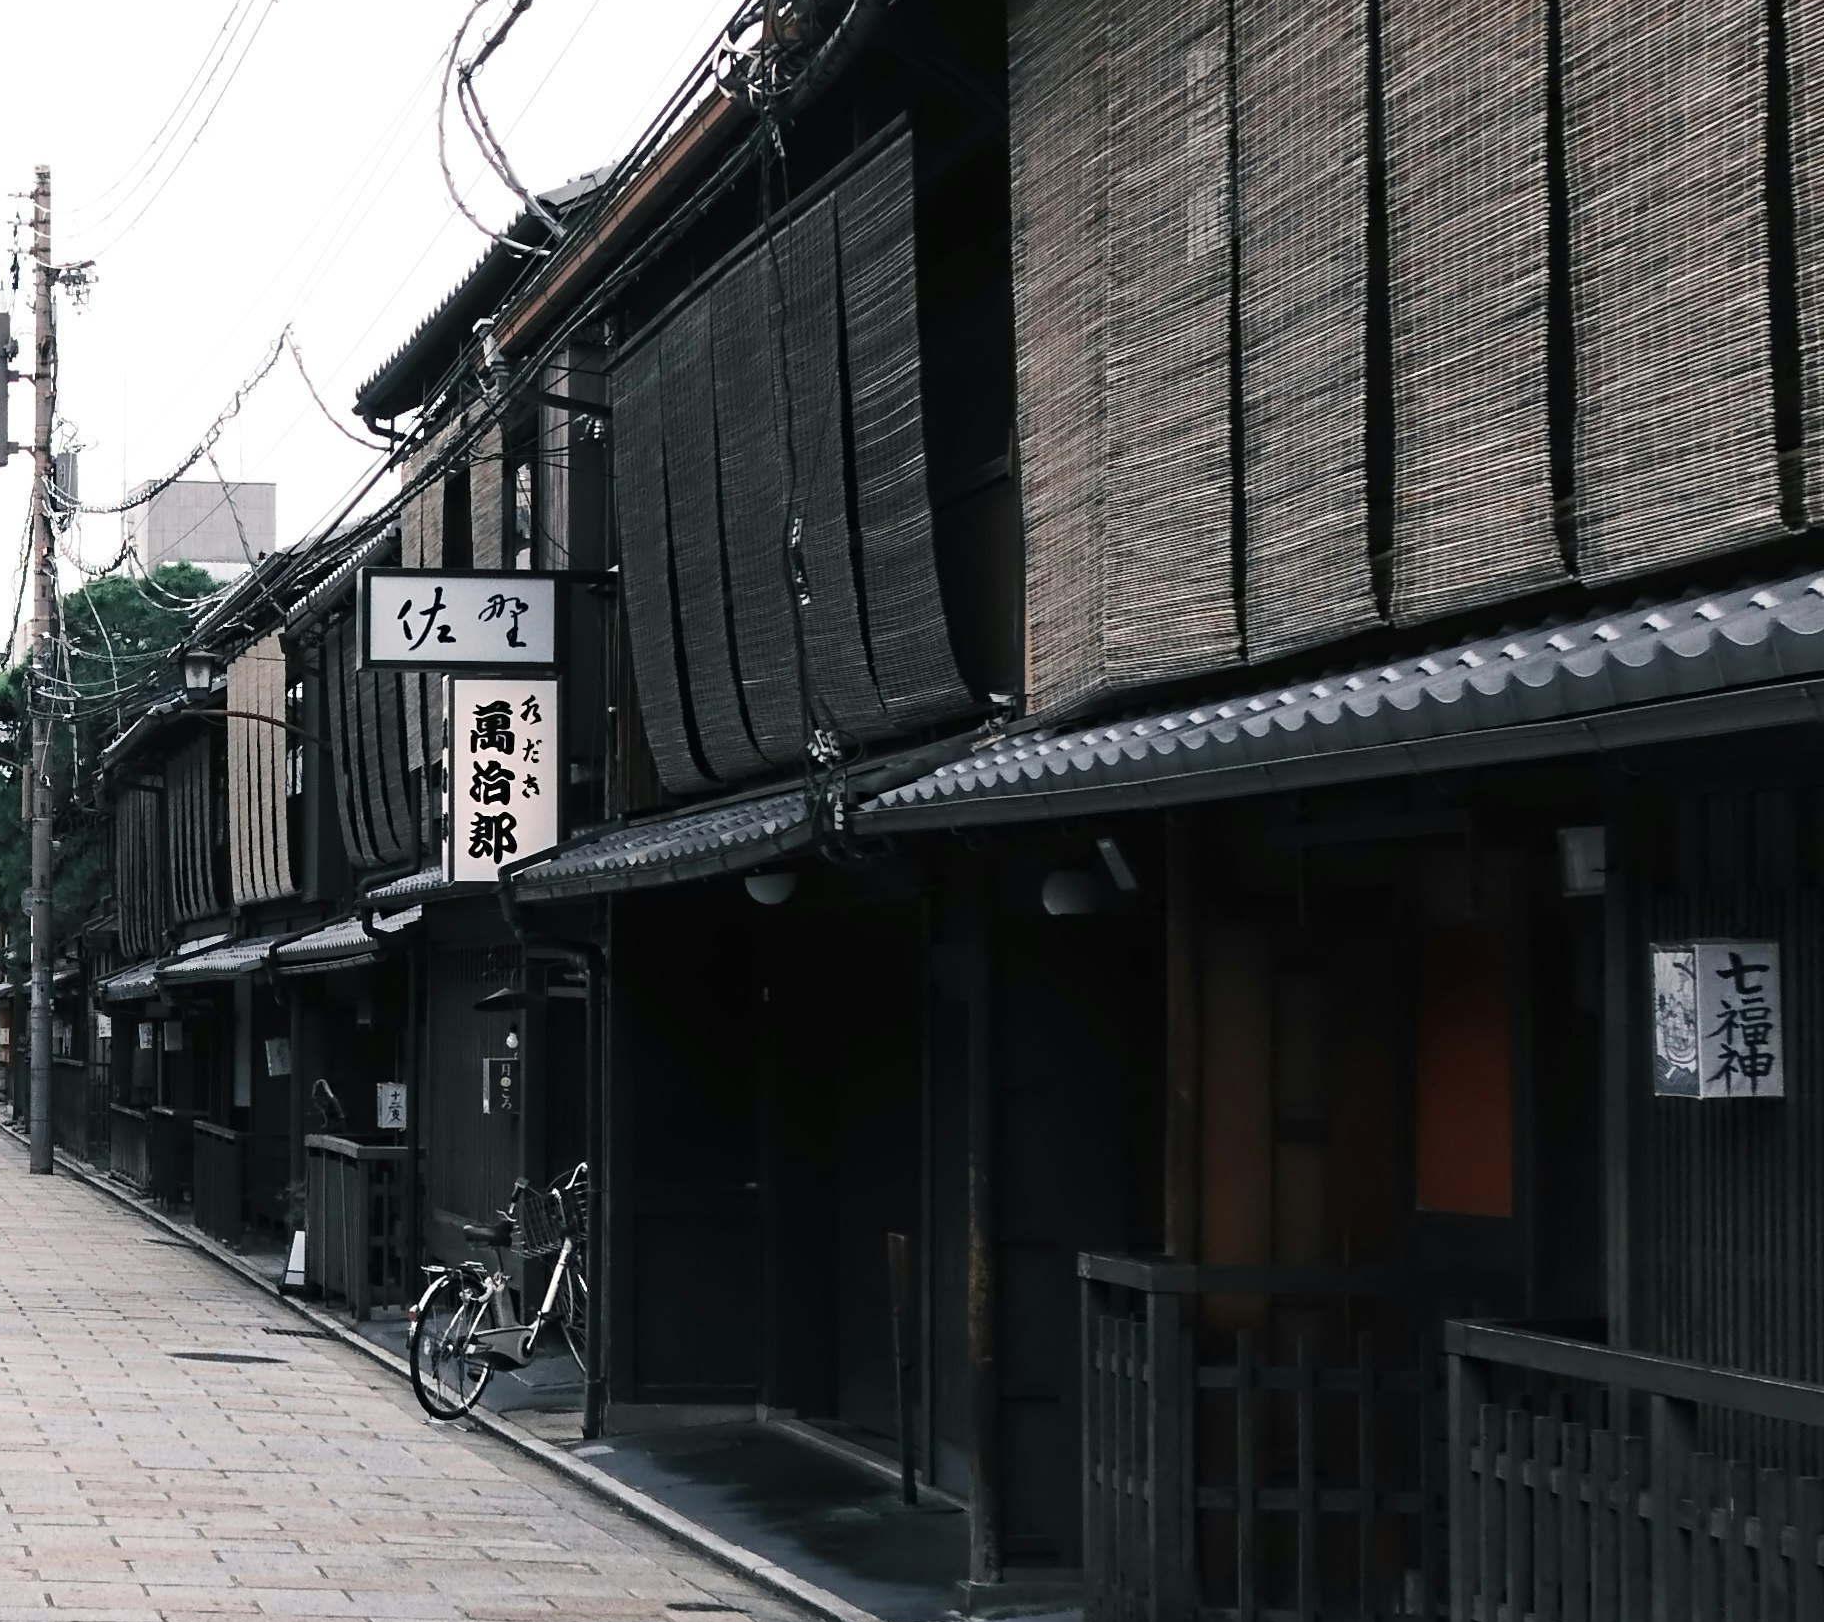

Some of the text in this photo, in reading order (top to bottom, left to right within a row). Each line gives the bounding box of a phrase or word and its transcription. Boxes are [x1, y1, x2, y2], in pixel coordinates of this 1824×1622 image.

[396, 586, 530, 651] 佐野
[467, 699, 518, 865] 萬治郎
[1704, 950, 1776, 1096] 七福神
